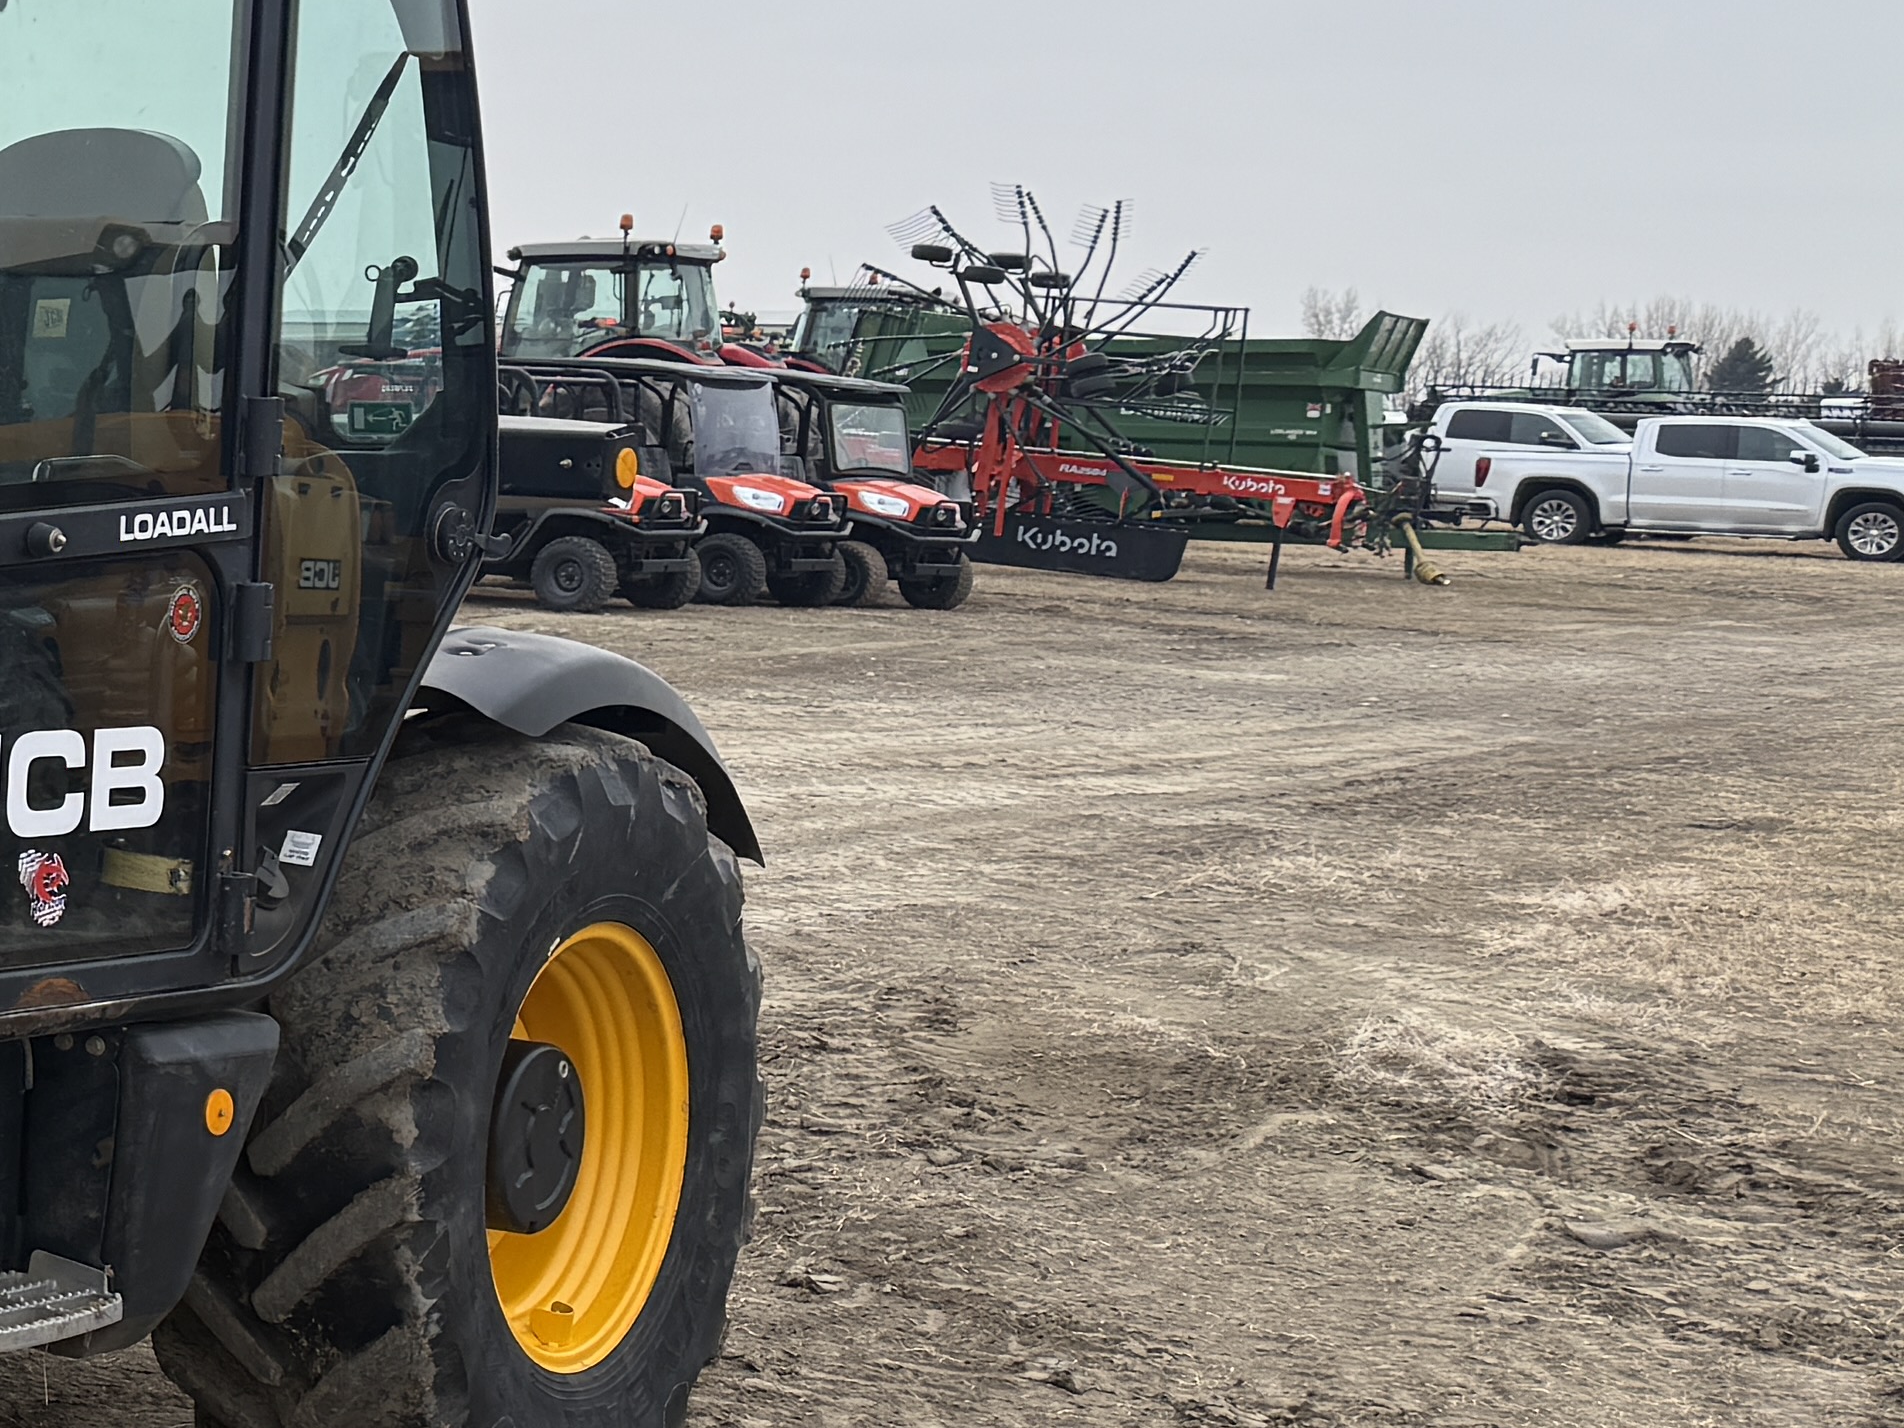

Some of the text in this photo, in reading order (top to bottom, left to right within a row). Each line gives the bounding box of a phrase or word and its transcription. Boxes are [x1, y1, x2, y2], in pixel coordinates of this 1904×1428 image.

[1222, 475, 1286, 495] Kubota
[119, 505, 238, 542] LOADALL
[1017, 525, 1118, 558] Kubota
